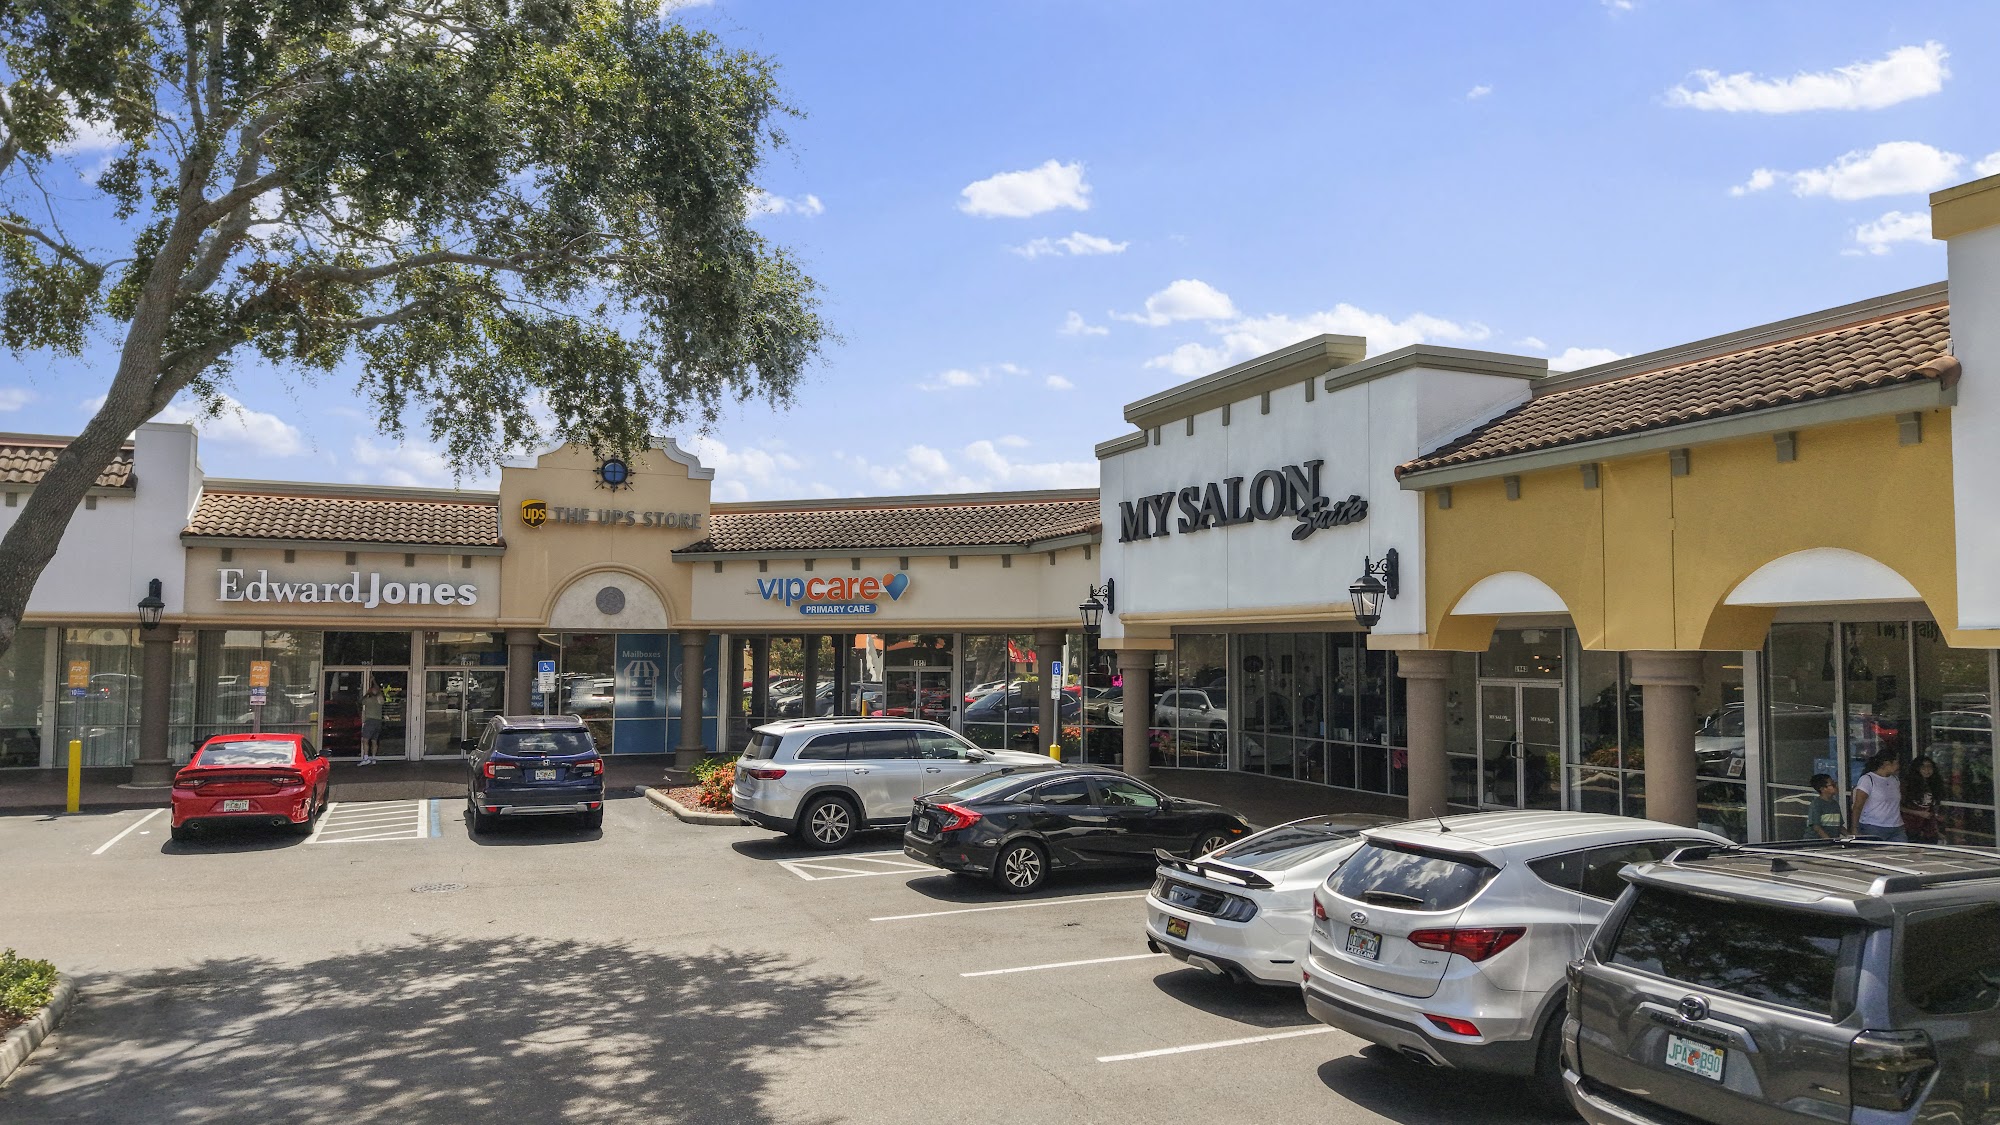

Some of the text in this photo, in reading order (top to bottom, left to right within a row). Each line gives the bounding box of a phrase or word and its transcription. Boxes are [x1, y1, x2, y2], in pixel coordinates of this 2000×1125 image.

[1118, 459, 1368, 543] MY SALON Suite
[523, 507, 547, 523] ups
[554, 507, 702, 530] THE UPS STORE
[756, 576, 880, 607] vipcare
[806, 604, 870, 614] PRIMARY CARE
[622, 650, 661, 658] Mailboxes
[1668, 1042, 1687, 1064] JPA
[1700, 1051, 1720, 1073] B90
